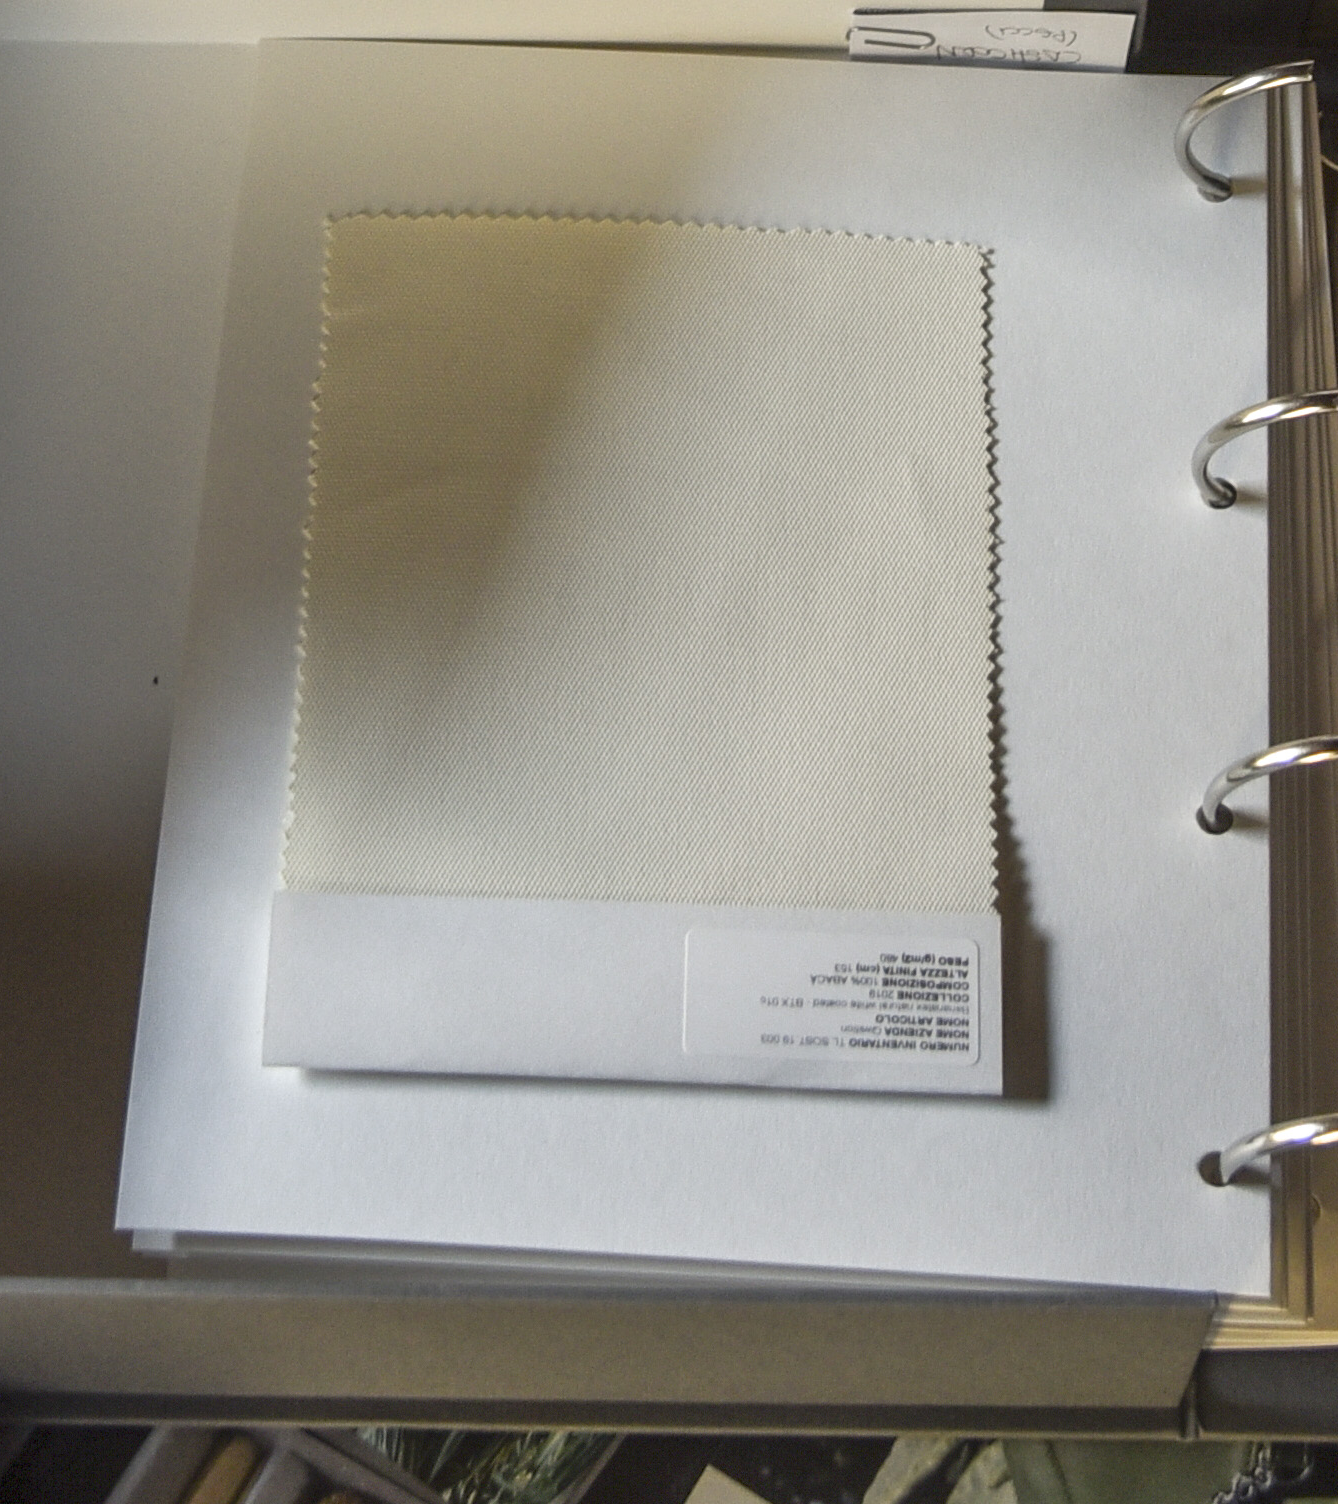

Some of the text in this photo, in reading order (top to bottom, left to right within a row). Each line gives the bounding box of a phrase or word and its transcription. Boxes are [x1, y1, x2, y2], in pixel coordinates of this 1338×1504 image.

[938, 956, 969, 967] PESO
[883, 966, 917, 977] FINITA
[920, 968, 969, 979] ALTEZZA
[882, 977, 970, 991] COMPOSIZIONE
[868, 989, 970, 1002] COLLEZIONE 2019
[875, 1014, 970, 1027] NOME ARTICOLO
[884, 1027, 933, 1038] AZIENDA
[936, 1029, 970, 1039] NOME
[848, 1038, 916, 1049] INVENTARIO
[919, 1041, 970, 1051] NUMERO
